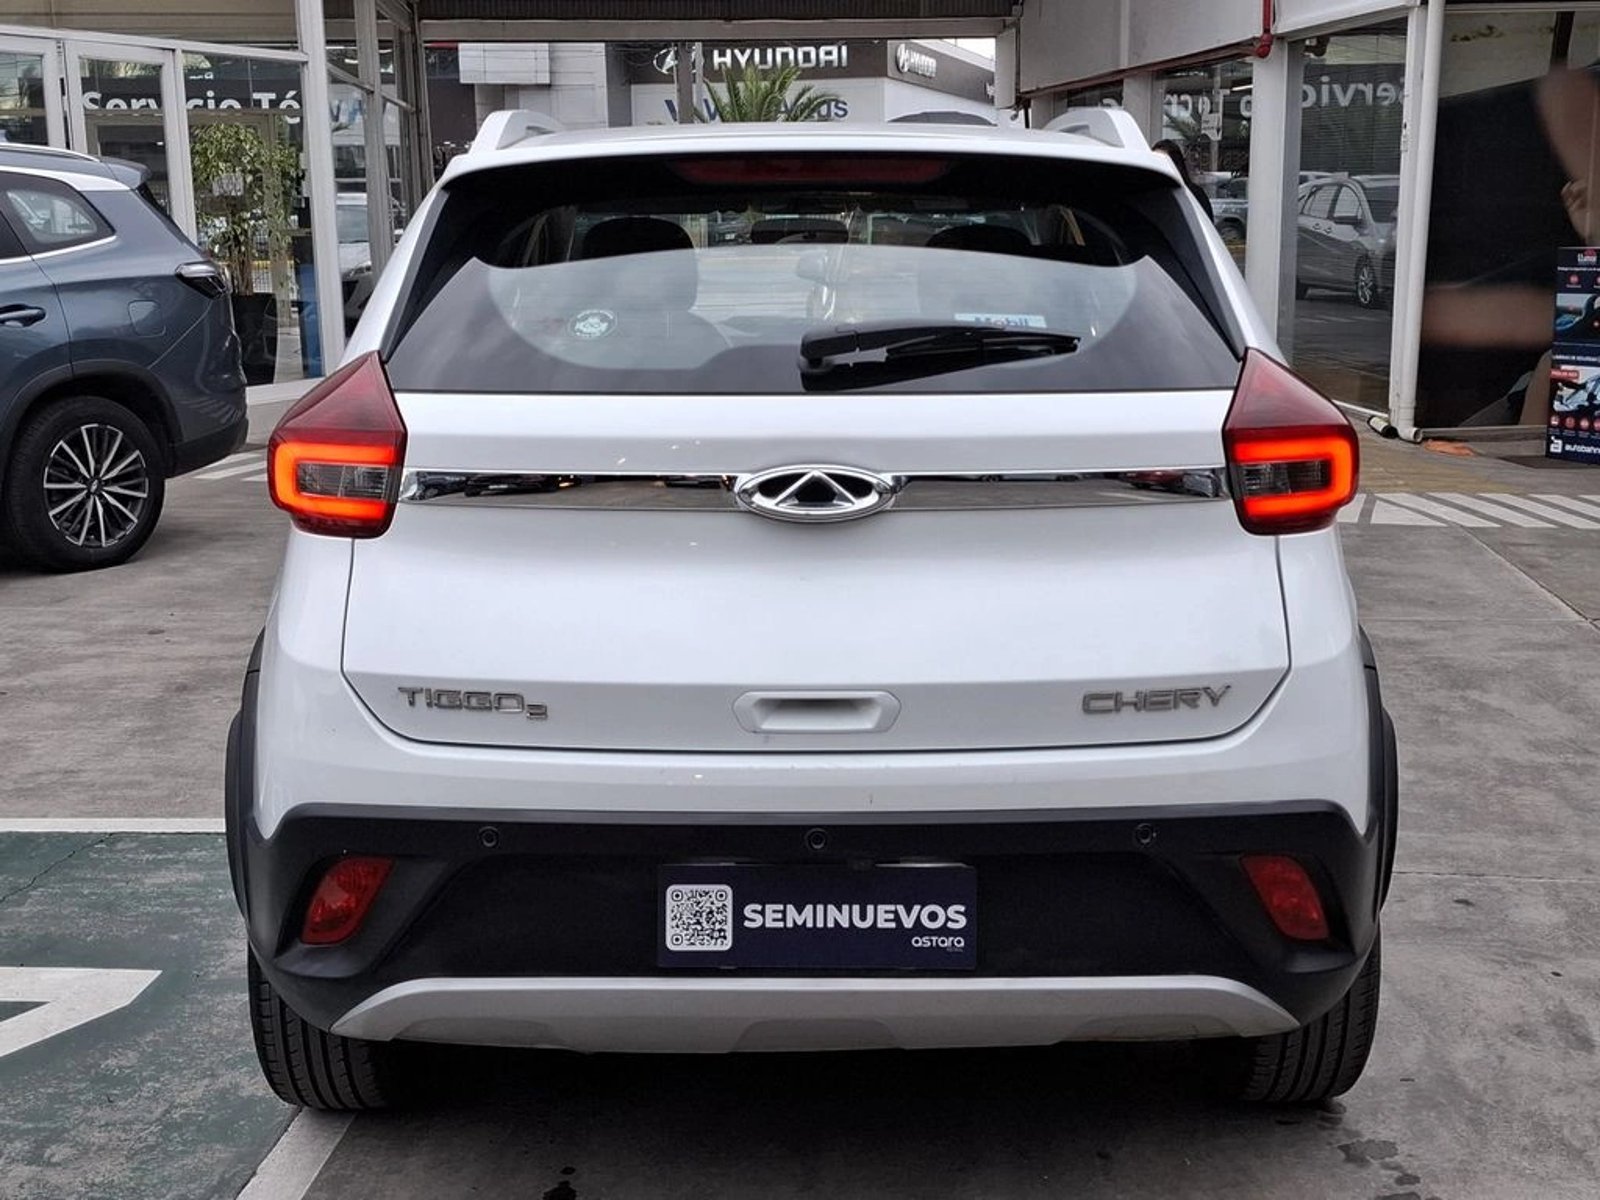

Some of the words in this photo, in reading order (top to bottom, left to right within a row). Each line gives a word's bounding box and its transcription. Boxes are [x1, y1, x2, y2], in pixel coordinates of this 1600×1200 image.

[713, 44, 848, 71] HYUNDAI
[1082, 685, 1232, 714] CHERY
[743, 903, 967, 929] SEMINUEVOS
[911, 936, 965, 948] astara
